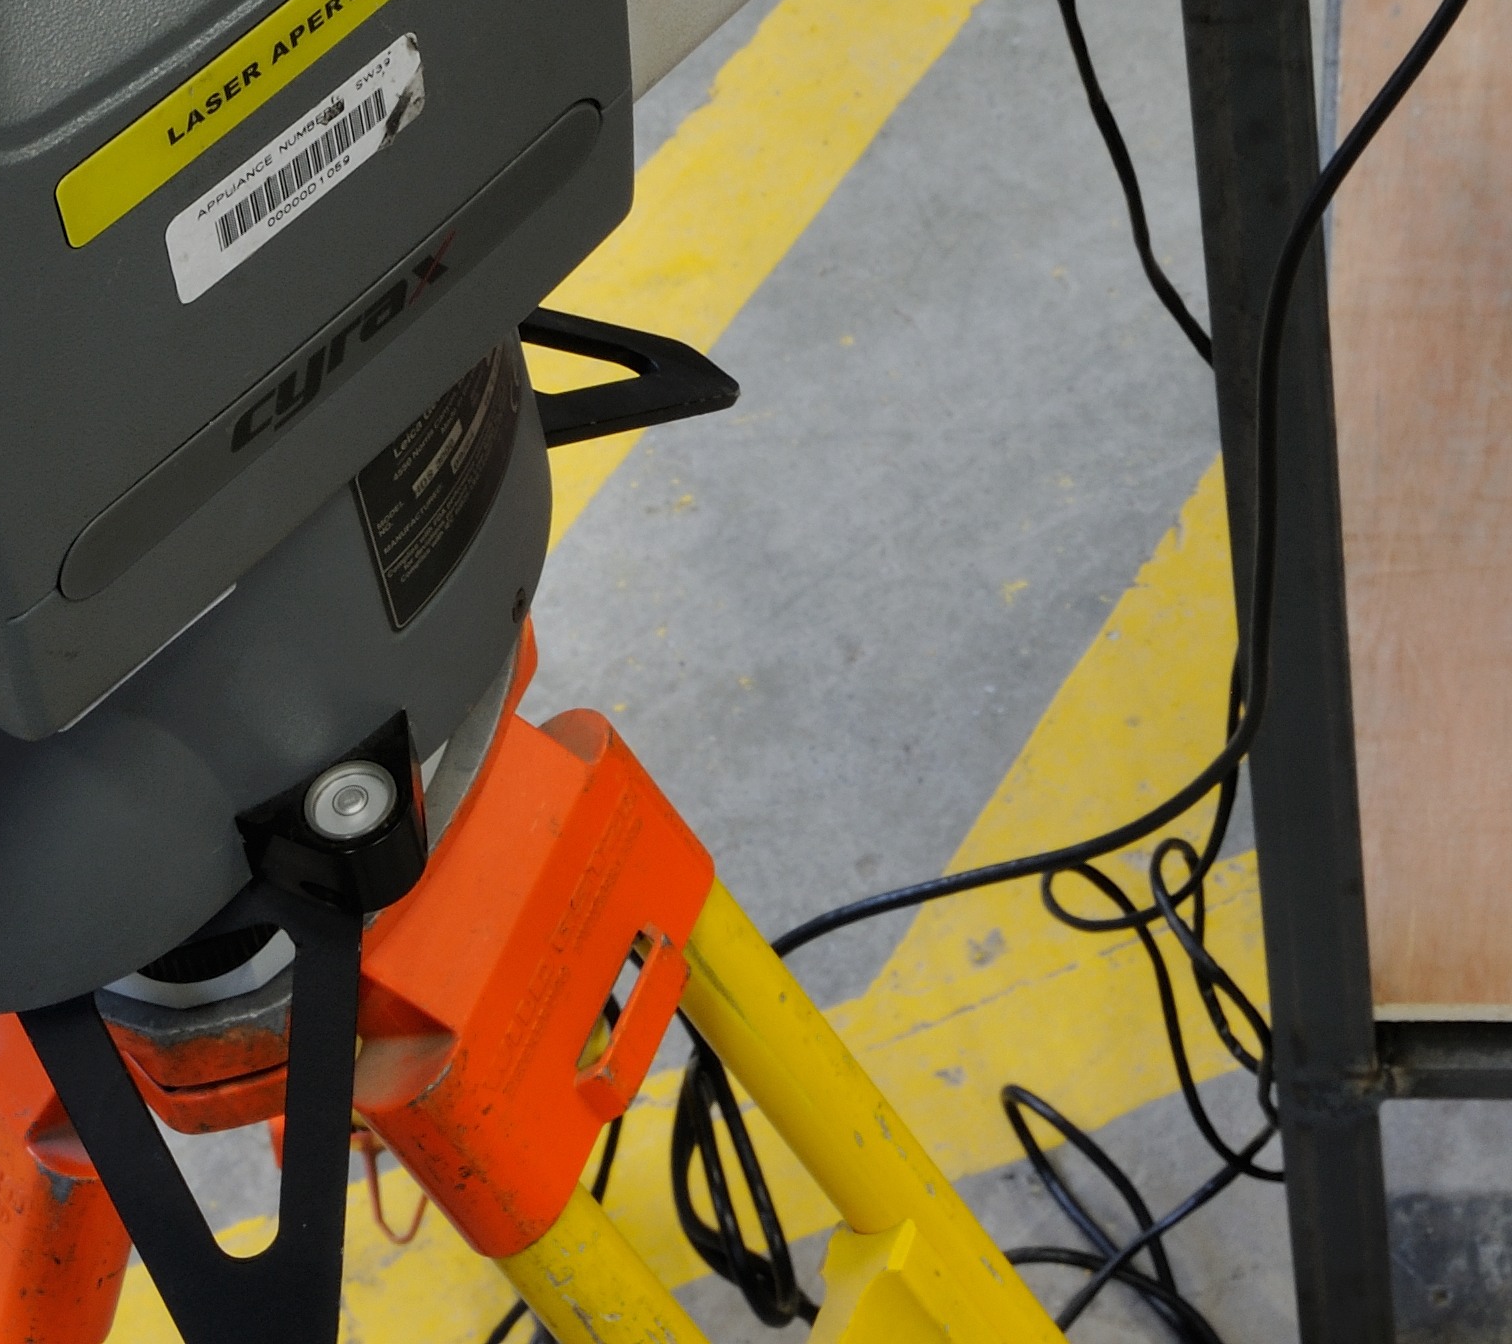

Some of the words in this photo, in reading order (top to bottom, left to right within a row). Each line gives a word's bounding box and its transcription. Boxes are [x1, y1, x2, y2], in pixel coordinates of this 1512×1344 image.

[166, 61, 262, 146] LASER
[196, 154, 274, 220] APPLIANCE
[230, 229, 456, 454] cyrax
[392, 420, 424, 459] Leica
